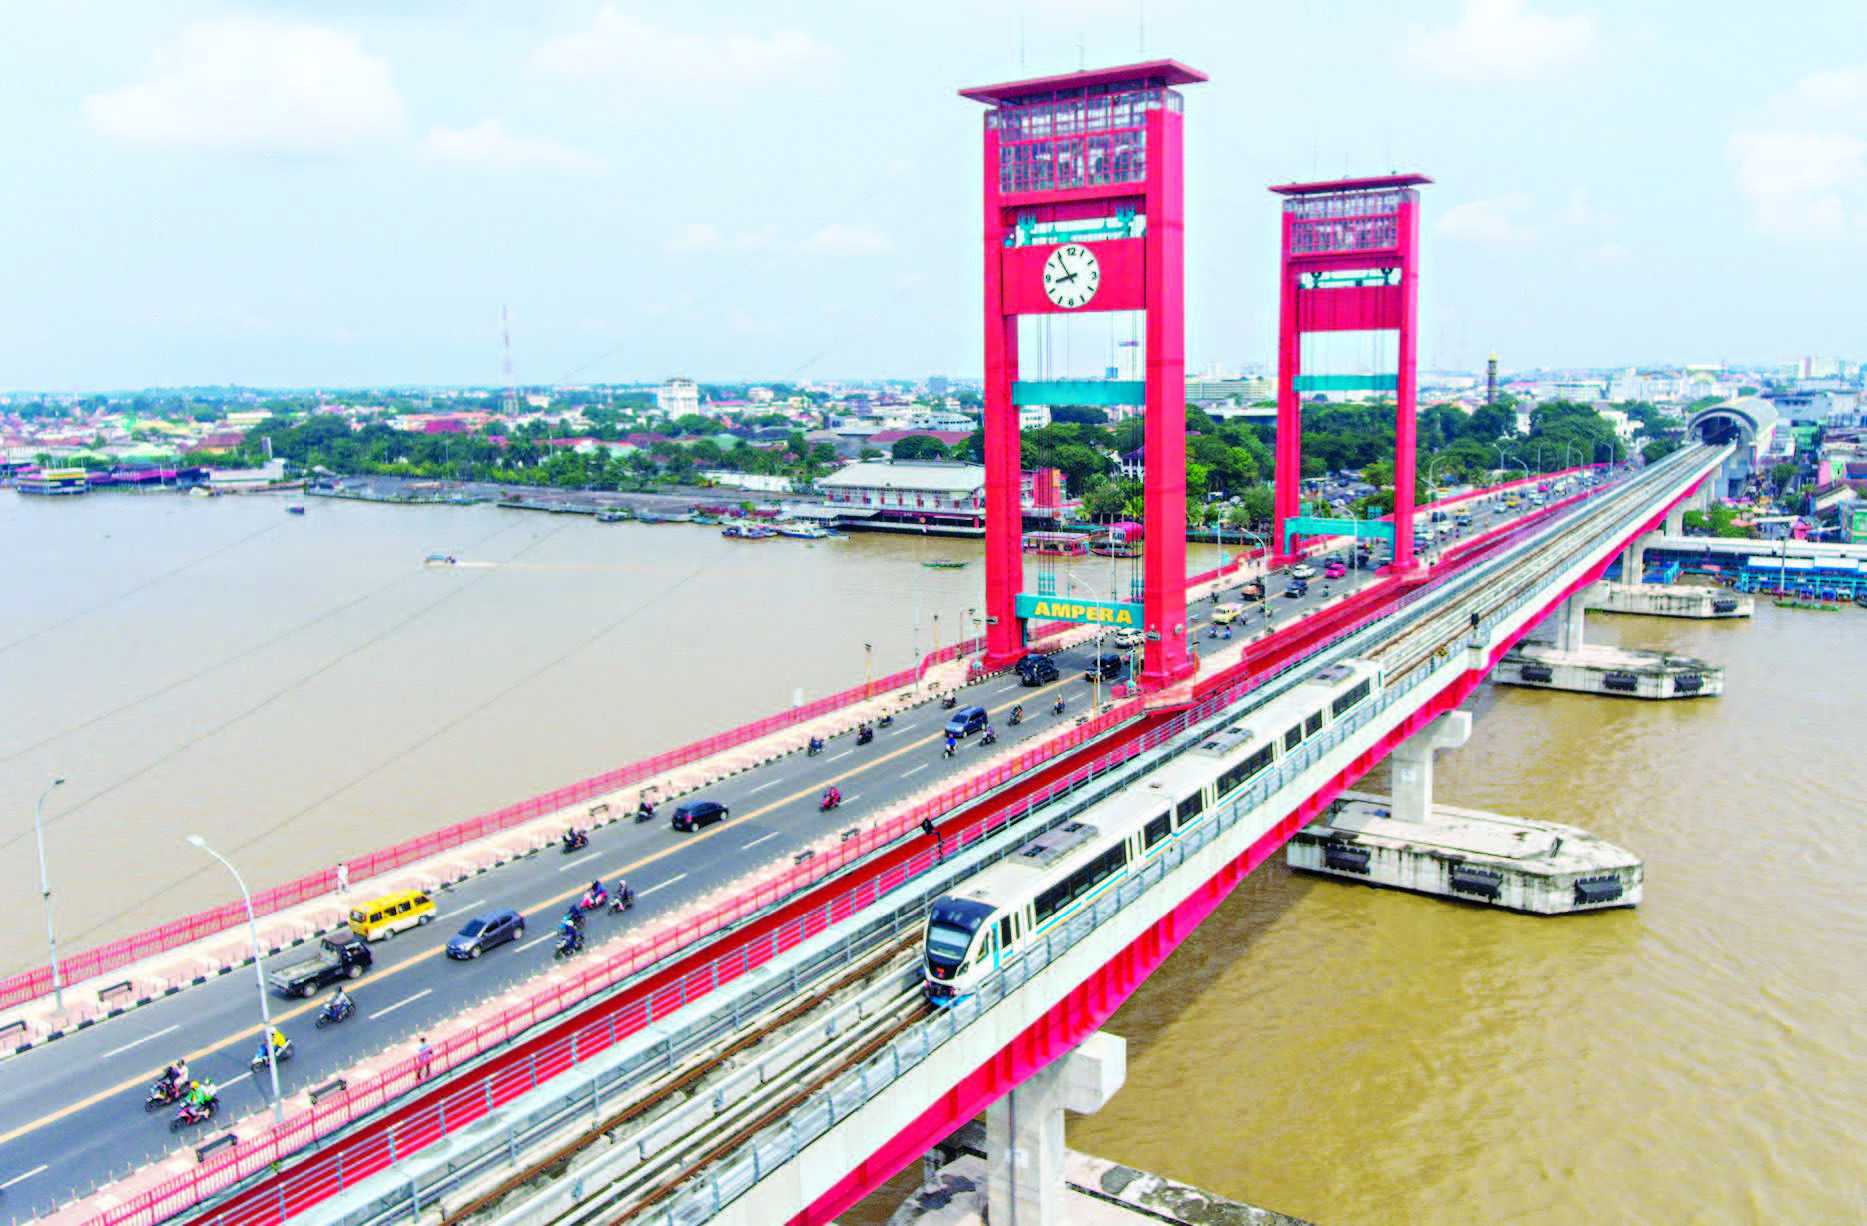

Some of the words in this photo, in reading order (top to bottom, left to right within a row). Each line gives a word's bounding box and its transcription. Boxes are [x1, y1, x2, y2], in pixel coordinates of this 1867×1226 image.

[1067, 247, 1076, 256] 12
[1045, 274, 1051, 283] 9
[1091, 271, 1097, 280] 3
[1068, 298, 1074, 306] 6
[1034, 602, 1132, 624] AMPERA
